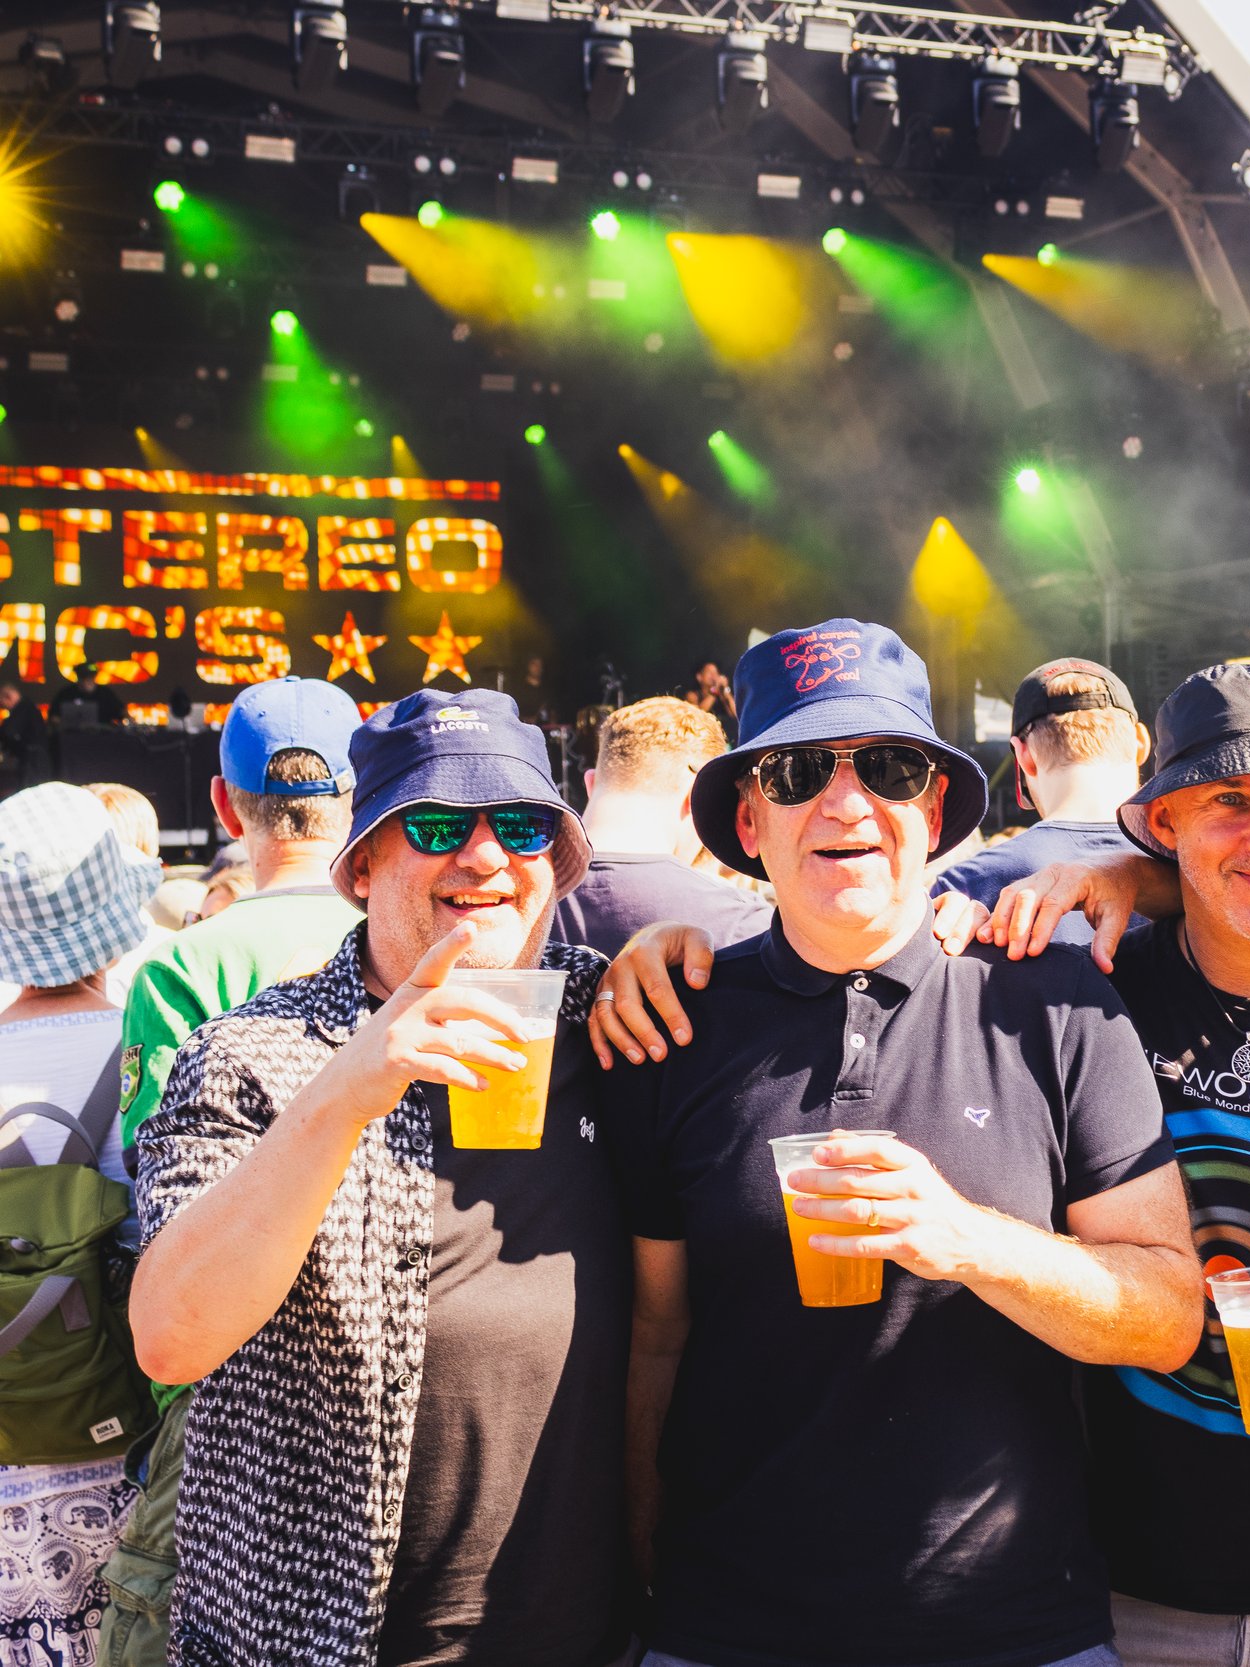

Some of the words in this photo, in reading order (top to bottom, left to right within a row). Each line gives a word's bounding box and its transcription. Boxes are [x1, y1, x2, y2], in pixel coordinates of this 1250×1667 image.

[0, 508, 503, 594] TEREO
[430, 721, 490, 734] LACOSTE
[1183, 1085, 1211, 1102] Blue
